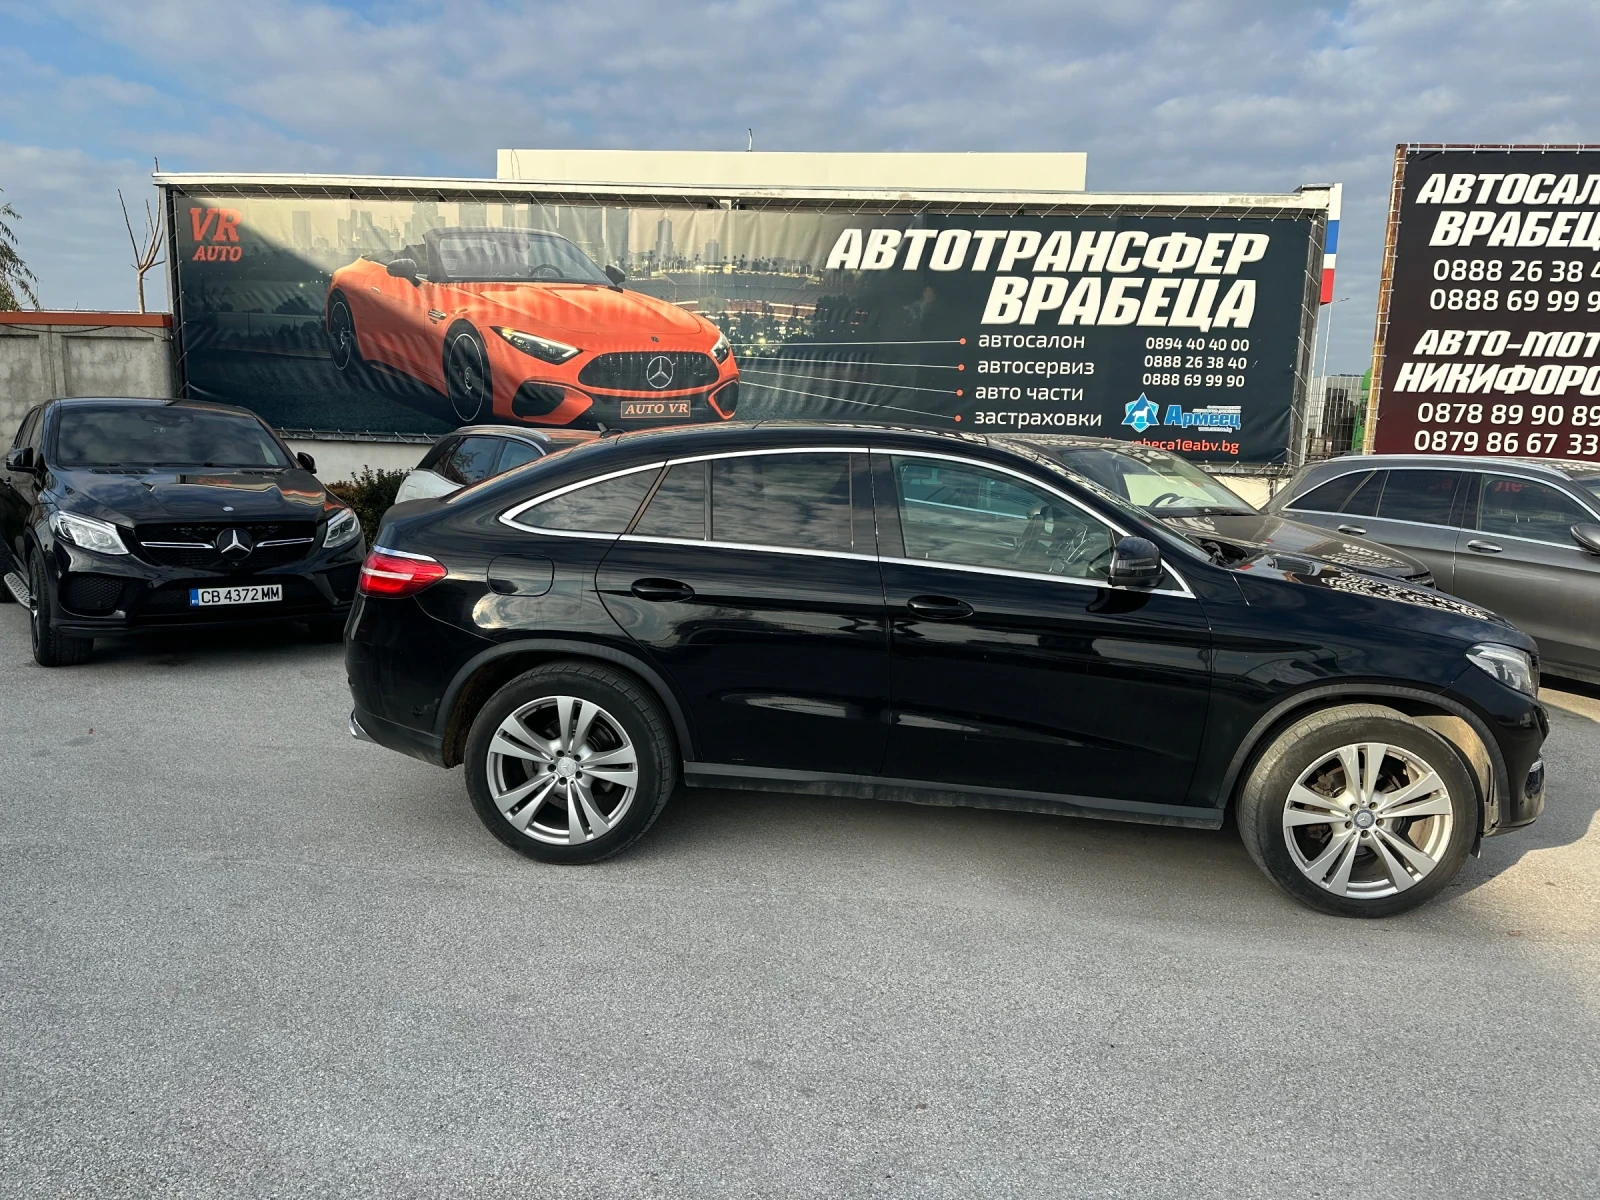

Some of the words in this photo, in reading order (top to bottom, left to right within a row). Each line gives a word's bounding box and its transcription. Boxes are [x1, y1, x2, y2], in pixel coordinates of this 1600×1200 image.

[1415, 173, 1600, 205] АВТОСАЛ
[189, 208, 242, 242] VR
[192, 245, 242, 262] AUTO
[825, 228, 1270, 275] АВТОТРАНСФЕР
[1433, 259, 1503, 282] 0888
[1509, 260, 1543, 282] 26
[1549, 260, 1584, 283] 38
[980, 276, 1256, 333] ВРАБЕЦА
[1429, 288, 1499, 311] 0888
[1506, 289, 1540, 312] 69
[1546, 290, 1580, 312] 99
[977, 334, 1086, 351] автосалон
[1145, 337, 1183, 350] 0894
[1186, 338, 1206, 351] 40
[1208, 338, 1228, 351] 40
[1230, 339, 1250, 352] 00
[1413, 329, 1600, 358] АВТО-МОТ
[977, 360, 1096, 379] автосервиз
[1144, 355, 1182, 368] 0888
[1184, 356, 1203, 369] 26
[1206, 356, 1225, 369] 38
[1227, 357, 1248, 370] 40
[1142, 373, 1180, 386] 0888
[1183, 374, 1202, 387] 69
[1205, 374, 1223, 387] 99
[1226, 374, 1246, 388] 90
[1393, 363, 1600, 397] НИКИФОРО
[975, 386, 1022, 401] авто
[1026, 387, 1084, 402] части
[624, 403, 665, 415] AUTO
[668, 403, 689, 414] VR
[974, 410, 1102, 429] застраховки
[1163, 404, 1242, 430] Армеец
[1417, 402, 1483, 424] 0878
[1490, 404, 1524, 425] 89
[1530, 404, 1564, 426] 90
[1571, 405, 1600, 427] 89
[1413, 430, 1479, 452] 0879
[1485, 432, 1519, 453] 86
[1526, 432, 1559, 454] 67
[1566, 433, 1599, 455] 33
[201, 590, 221, 604] CB
[224, 588, 260, 602] 4372
[261, 586, 280, 600] MM
